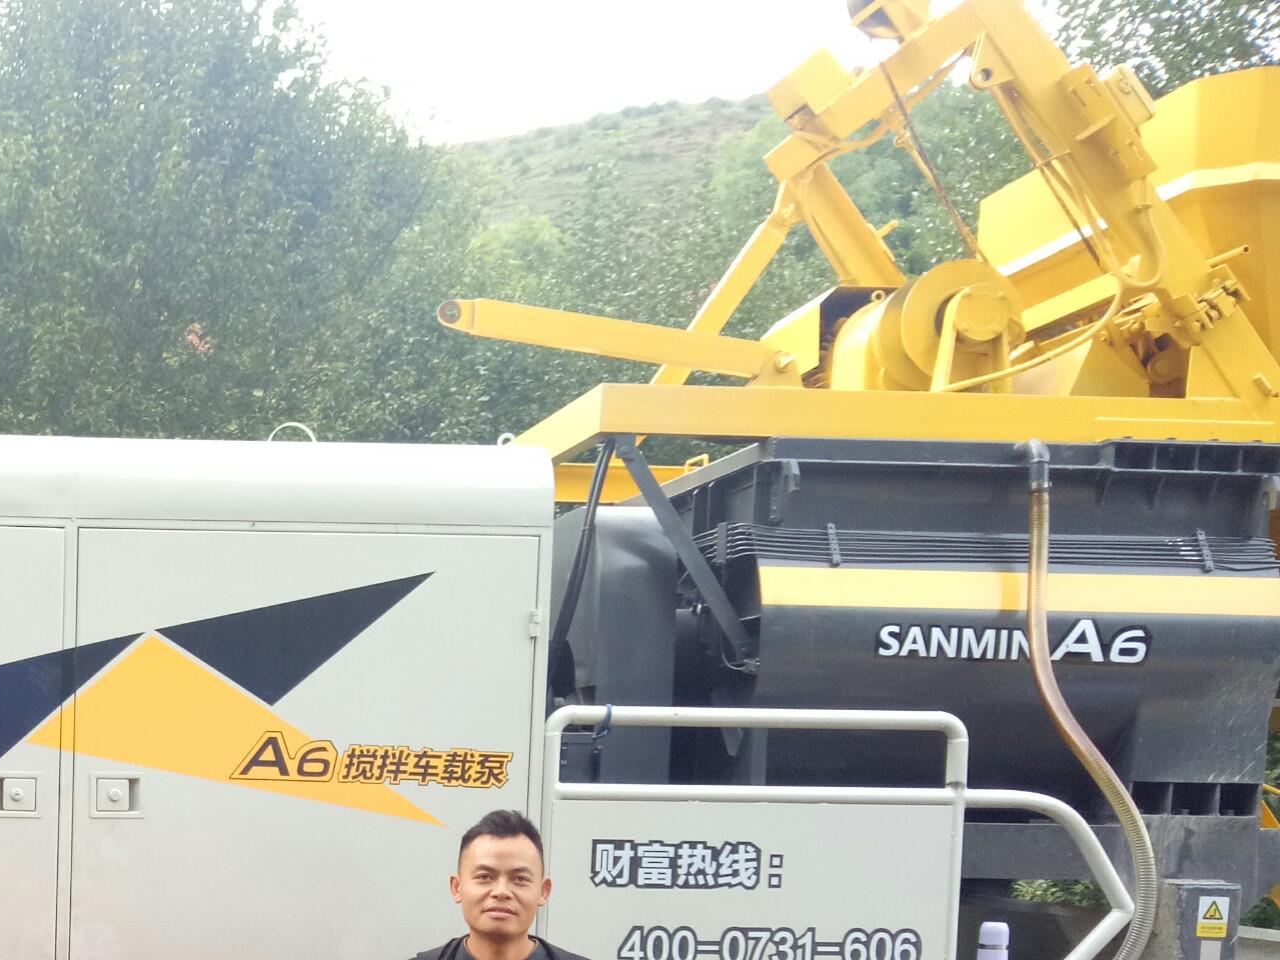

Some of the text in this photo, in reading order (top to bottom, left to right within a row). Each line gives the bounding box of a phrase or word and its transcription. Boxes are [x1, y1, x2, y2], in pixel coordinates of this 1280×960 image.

[877, 618, 1149, 664] SANMIN A6
[238, 735, 510, 786] A6 搅拌车载泵
